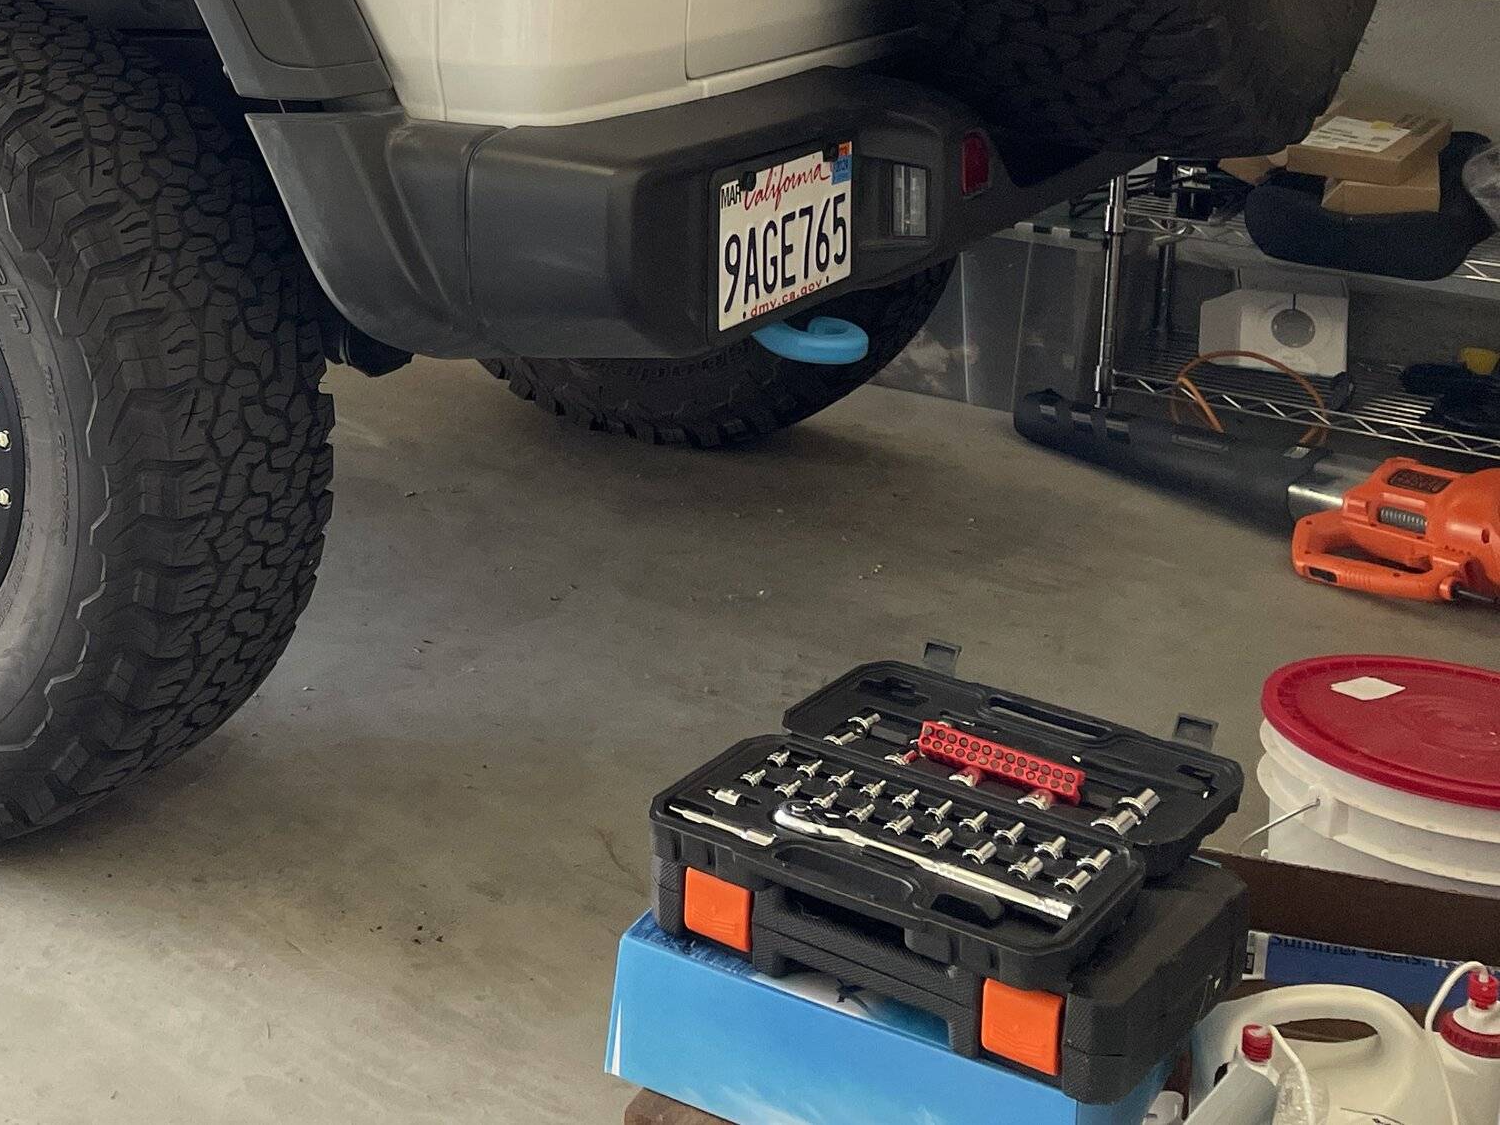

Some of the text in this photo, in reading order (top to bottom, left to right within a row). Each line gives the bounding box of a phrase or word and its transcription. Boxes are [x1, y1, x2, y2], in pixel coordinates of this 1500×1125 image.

[720, 181, 742, 210] MAR
[723, 191, 849, 314] 9AGE765
[750, 277, 824, 318] dmv.ca.gov
